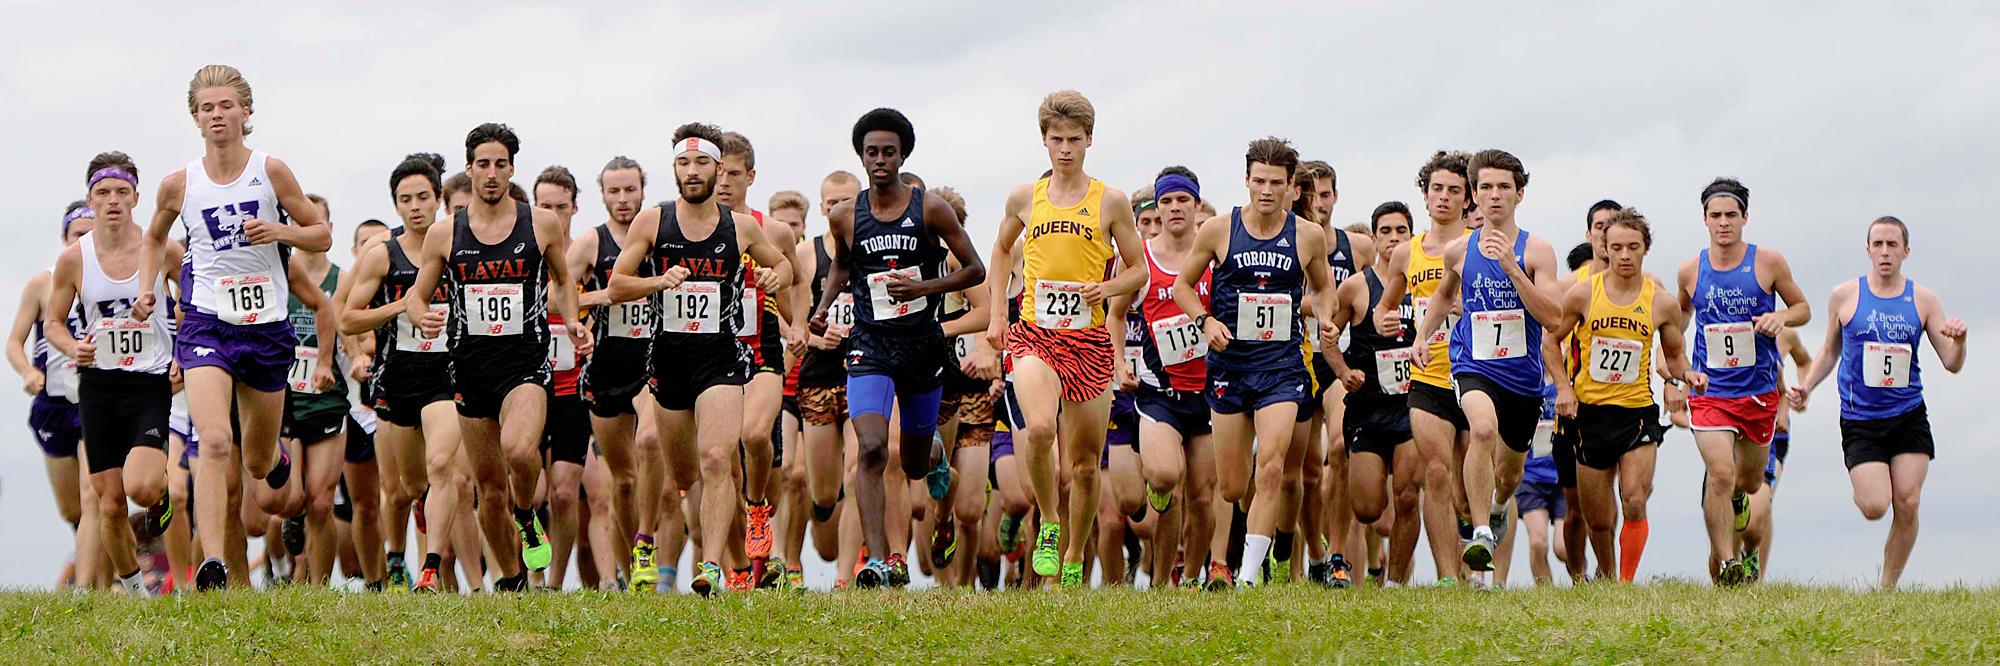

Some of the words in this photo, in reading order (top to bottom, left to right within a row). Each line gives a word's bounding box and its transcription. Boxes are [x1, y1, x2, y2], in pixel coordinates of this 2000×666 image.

[1032, 220, 1093, 241] QUEEN'S
[860, 234, 917, 254] TORONTO
[457, 259, 529, 282] LAVAL
[662, 256, 728, 277] LAVAL
[1233, 250, 1293, 271] TORONTO
[1484, 276, 1512, 289] Brock
[1717, 286, 1743, 298] Brock
[228, 284, 265, 311] 169
[675, 294, 709, 319] 192
[1046, 292, 1081, 316] 232
[1493, 299, 1517, 309] Club
[1721, 296, 1758, 307] Running
[478, 297, 511, 321] 196
[621, 304, 650, 325] 195
[1256, 306, 1275, 329] 51
[1727, 305, 1748, 316] Club
[1879, 312, 1906, 322] Brock
[1166, 324, 1199, 351] 113
[1493, 323, 1502, 346] 7
[1591, 317, 1649, 337] QUEEN'S
[1883, 321, 1917, 336] Running
[1887, 330, 1908, 340] Club
[108, 330, 143, 354] 150
[1724, 335, 1734, 356] 9
[1394, 359, 1411, 382] 58
[1599, 349, 1632, 372] 227
[1883, 355, 1892, 376] 5
